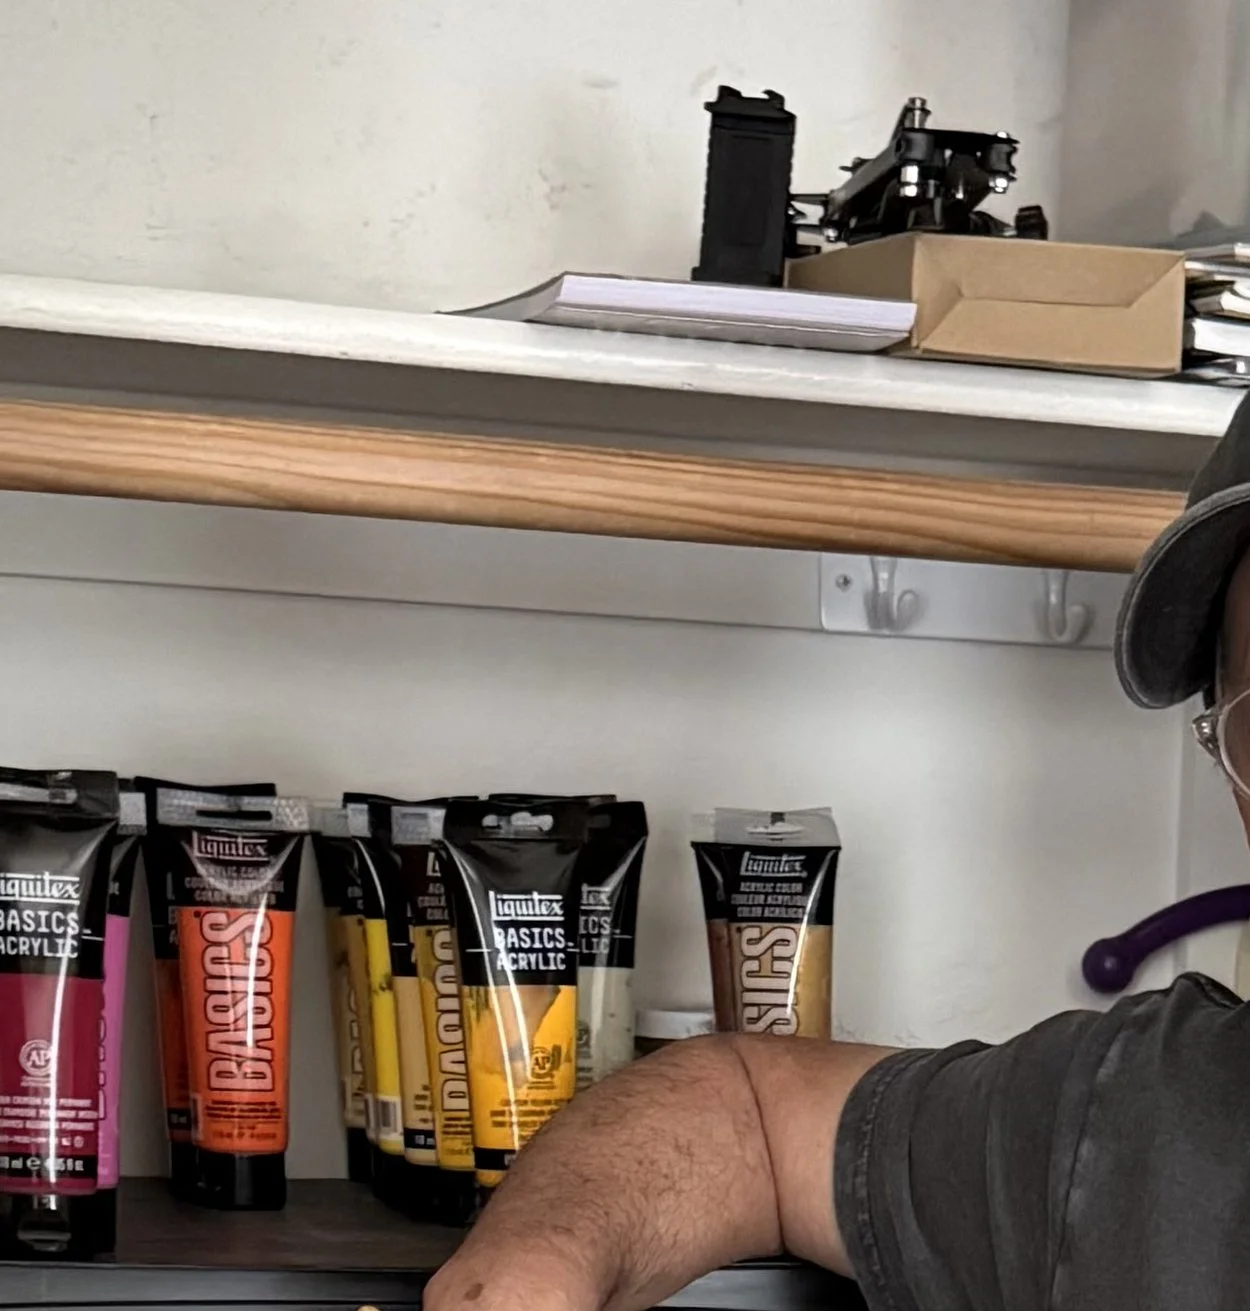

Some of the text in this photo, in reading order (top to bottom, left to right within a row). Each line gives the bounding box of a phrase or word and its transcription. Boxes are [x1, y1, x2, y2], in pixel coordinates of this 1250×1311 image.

[192, 830, 270, 862] Liquitex
[740, 850, 807, 878] Liquitex
[0, 871, 80, 906] iquitex
[488, 889, 565, 921] Liquitex
[494, 927, 566, 950] BASICS
[496, 952, 567, 971] ACRYLIC
[739, 924, 799, 1037] SICS
[200, 909, 274, 1093] BASICS
